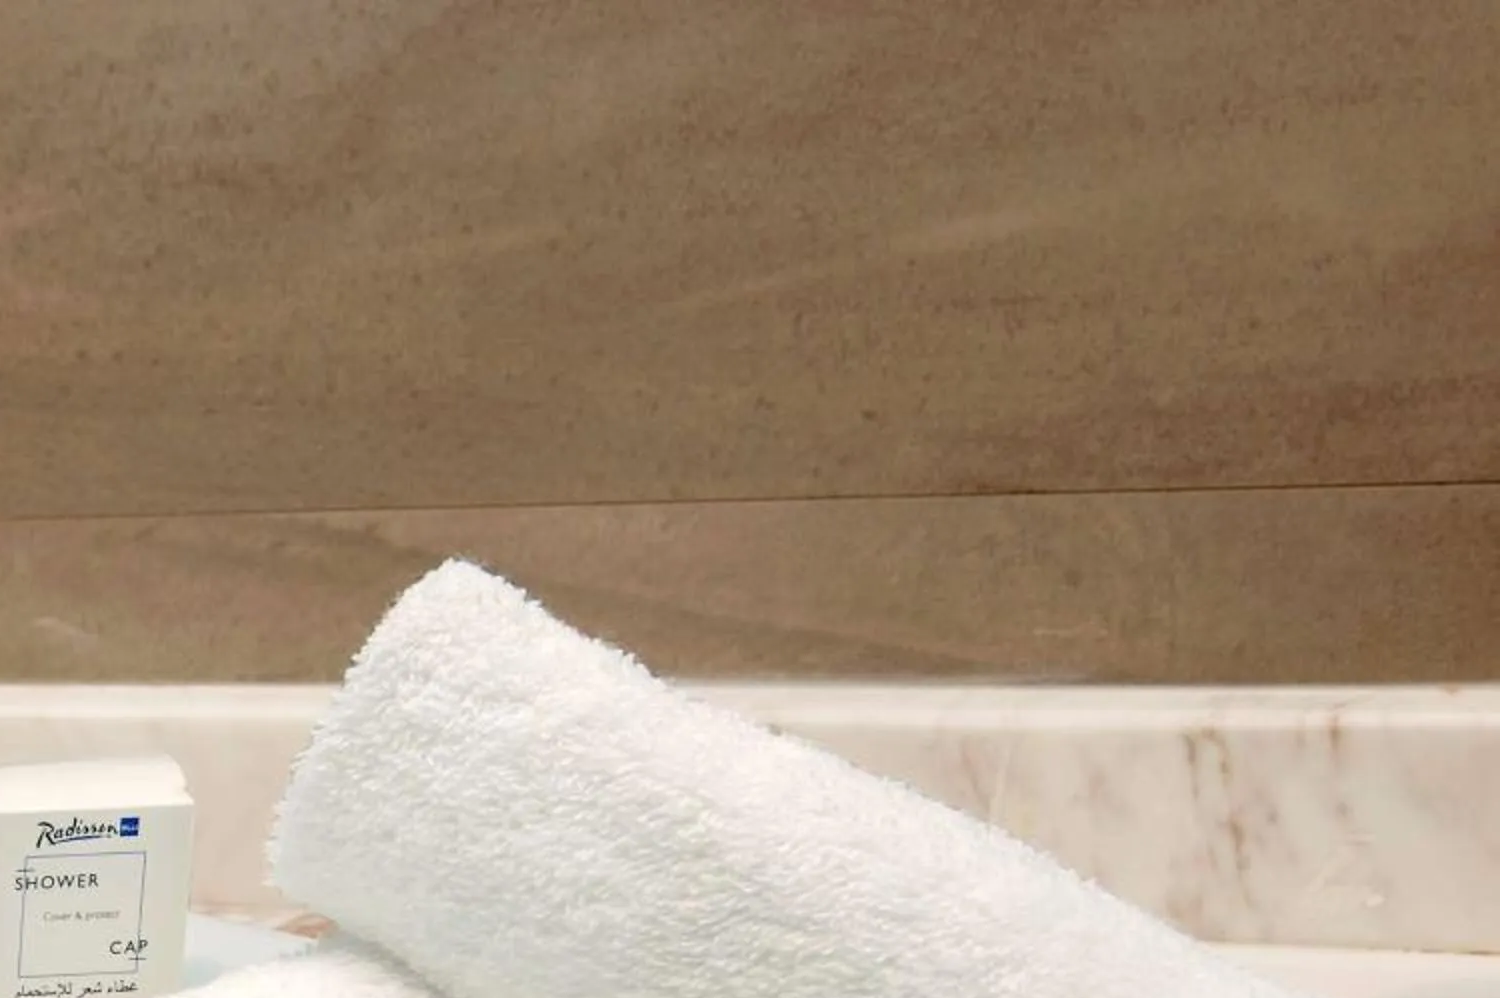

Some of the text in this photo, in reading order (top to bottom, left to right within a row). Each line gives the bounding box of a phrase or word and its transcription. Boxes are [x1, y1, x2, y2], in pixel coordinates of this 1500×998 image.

[36, 817, 118, 848] Radisson
[15, 873, 99, 891] SHOWER
[109, 939, 148, 955] CAP
